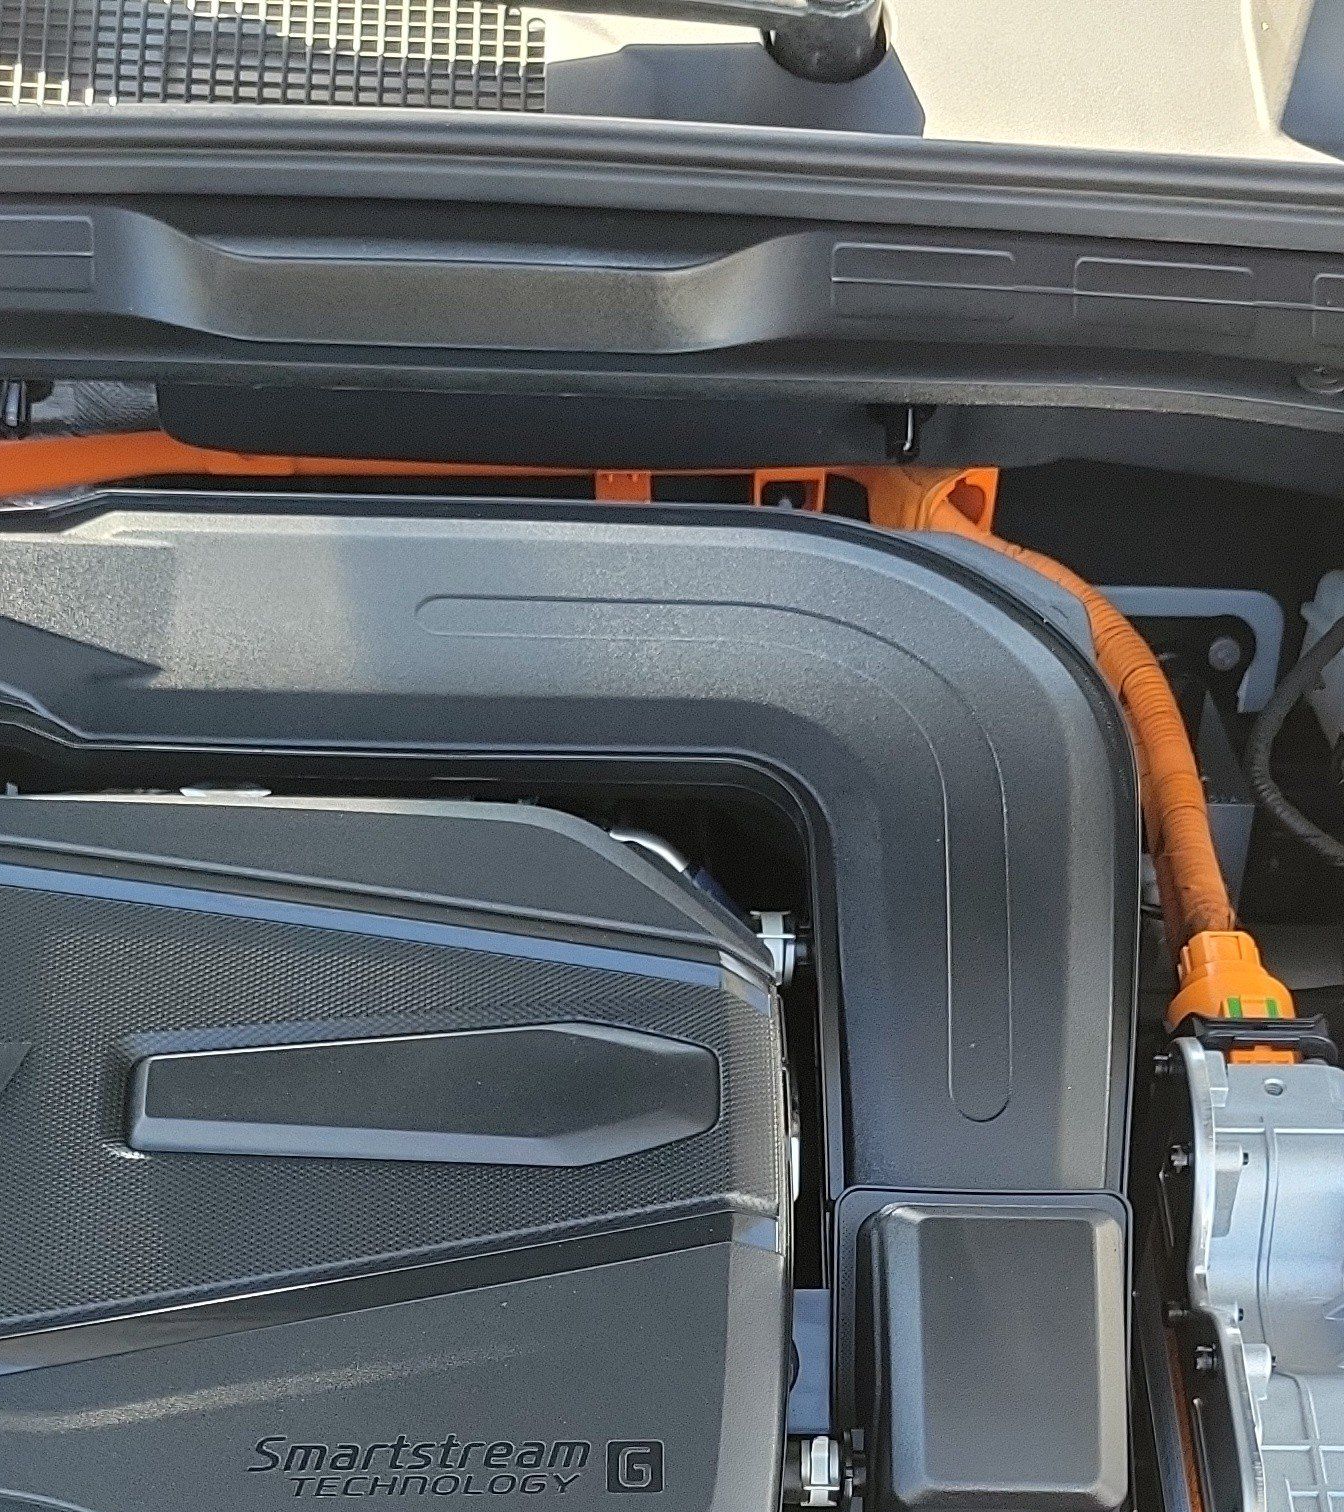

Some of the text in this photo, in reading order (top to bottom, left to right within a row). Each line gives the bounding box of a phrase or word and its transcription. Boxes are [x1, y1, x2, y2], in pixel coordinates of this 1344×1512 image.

[248, 1434, 656, 1489] Smartstream G
[290, 1473, 581, 1498] TECHNOLOGY
